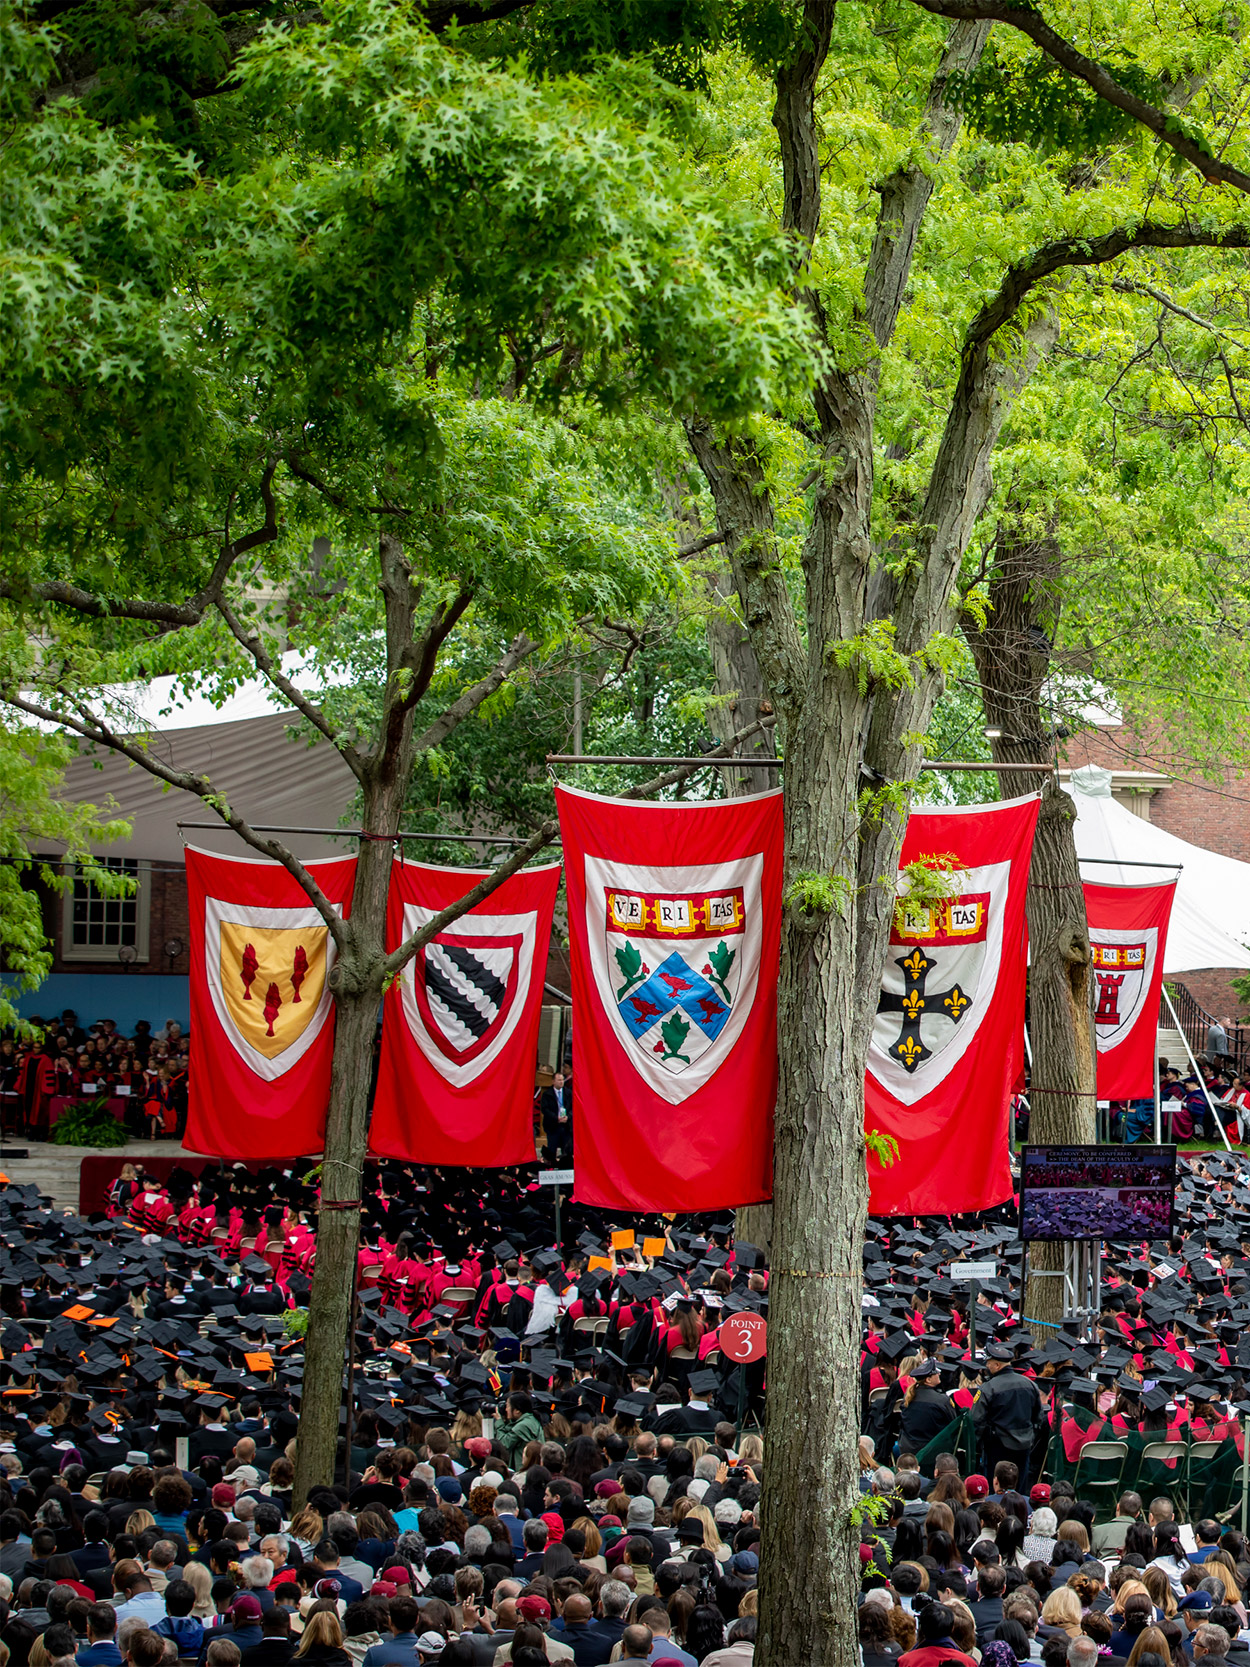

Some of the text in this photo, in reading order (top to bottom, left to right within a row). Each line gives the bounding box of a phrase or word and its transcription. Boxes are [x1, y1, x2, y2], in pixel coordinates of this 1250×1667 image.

[615, 901, 733, 921] VE RI TAS
[953, 910, 976, 925] TAS
[1103, 951, 1115, 960] RI
[1128, 951, 1141, 959] TAS
[730, 1319, 764, 1330] POINT
[734, 1329, 753, 1358] 3
